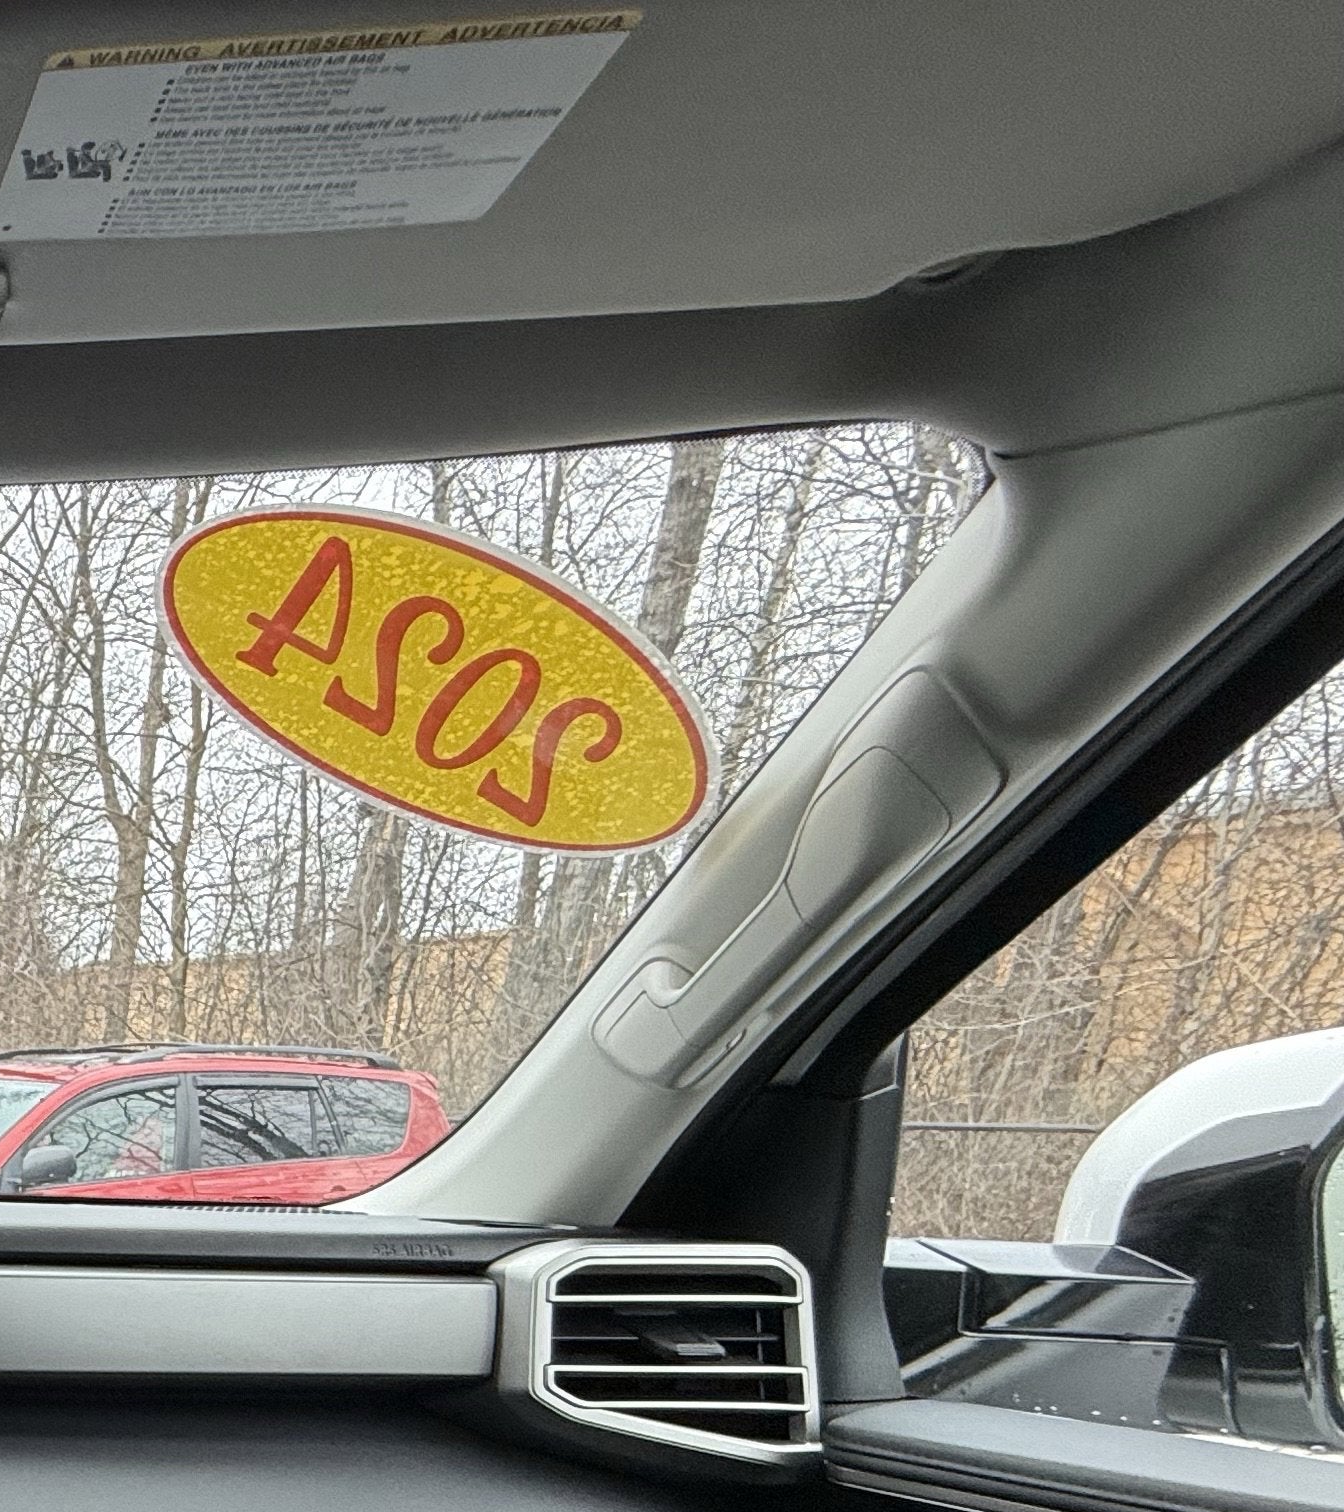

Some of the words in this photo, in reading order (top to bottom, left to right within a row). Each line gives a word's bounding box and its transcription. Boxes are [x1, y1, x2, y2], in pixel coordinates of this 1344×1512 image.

[89, 44, 201, 66] WARNING
[220, 30, 424, 57] AVERTISSEMENT
[440, 14, 624, 44] ADVERTENCIA
[185, 62, 218, 75] EVEN
[221, 60, 251, 73] WITH
[255, 56, 322, 72] ADVANCED
[324, 54, 347, 67] AIR
[349, 52, 386, 66] BAGS
